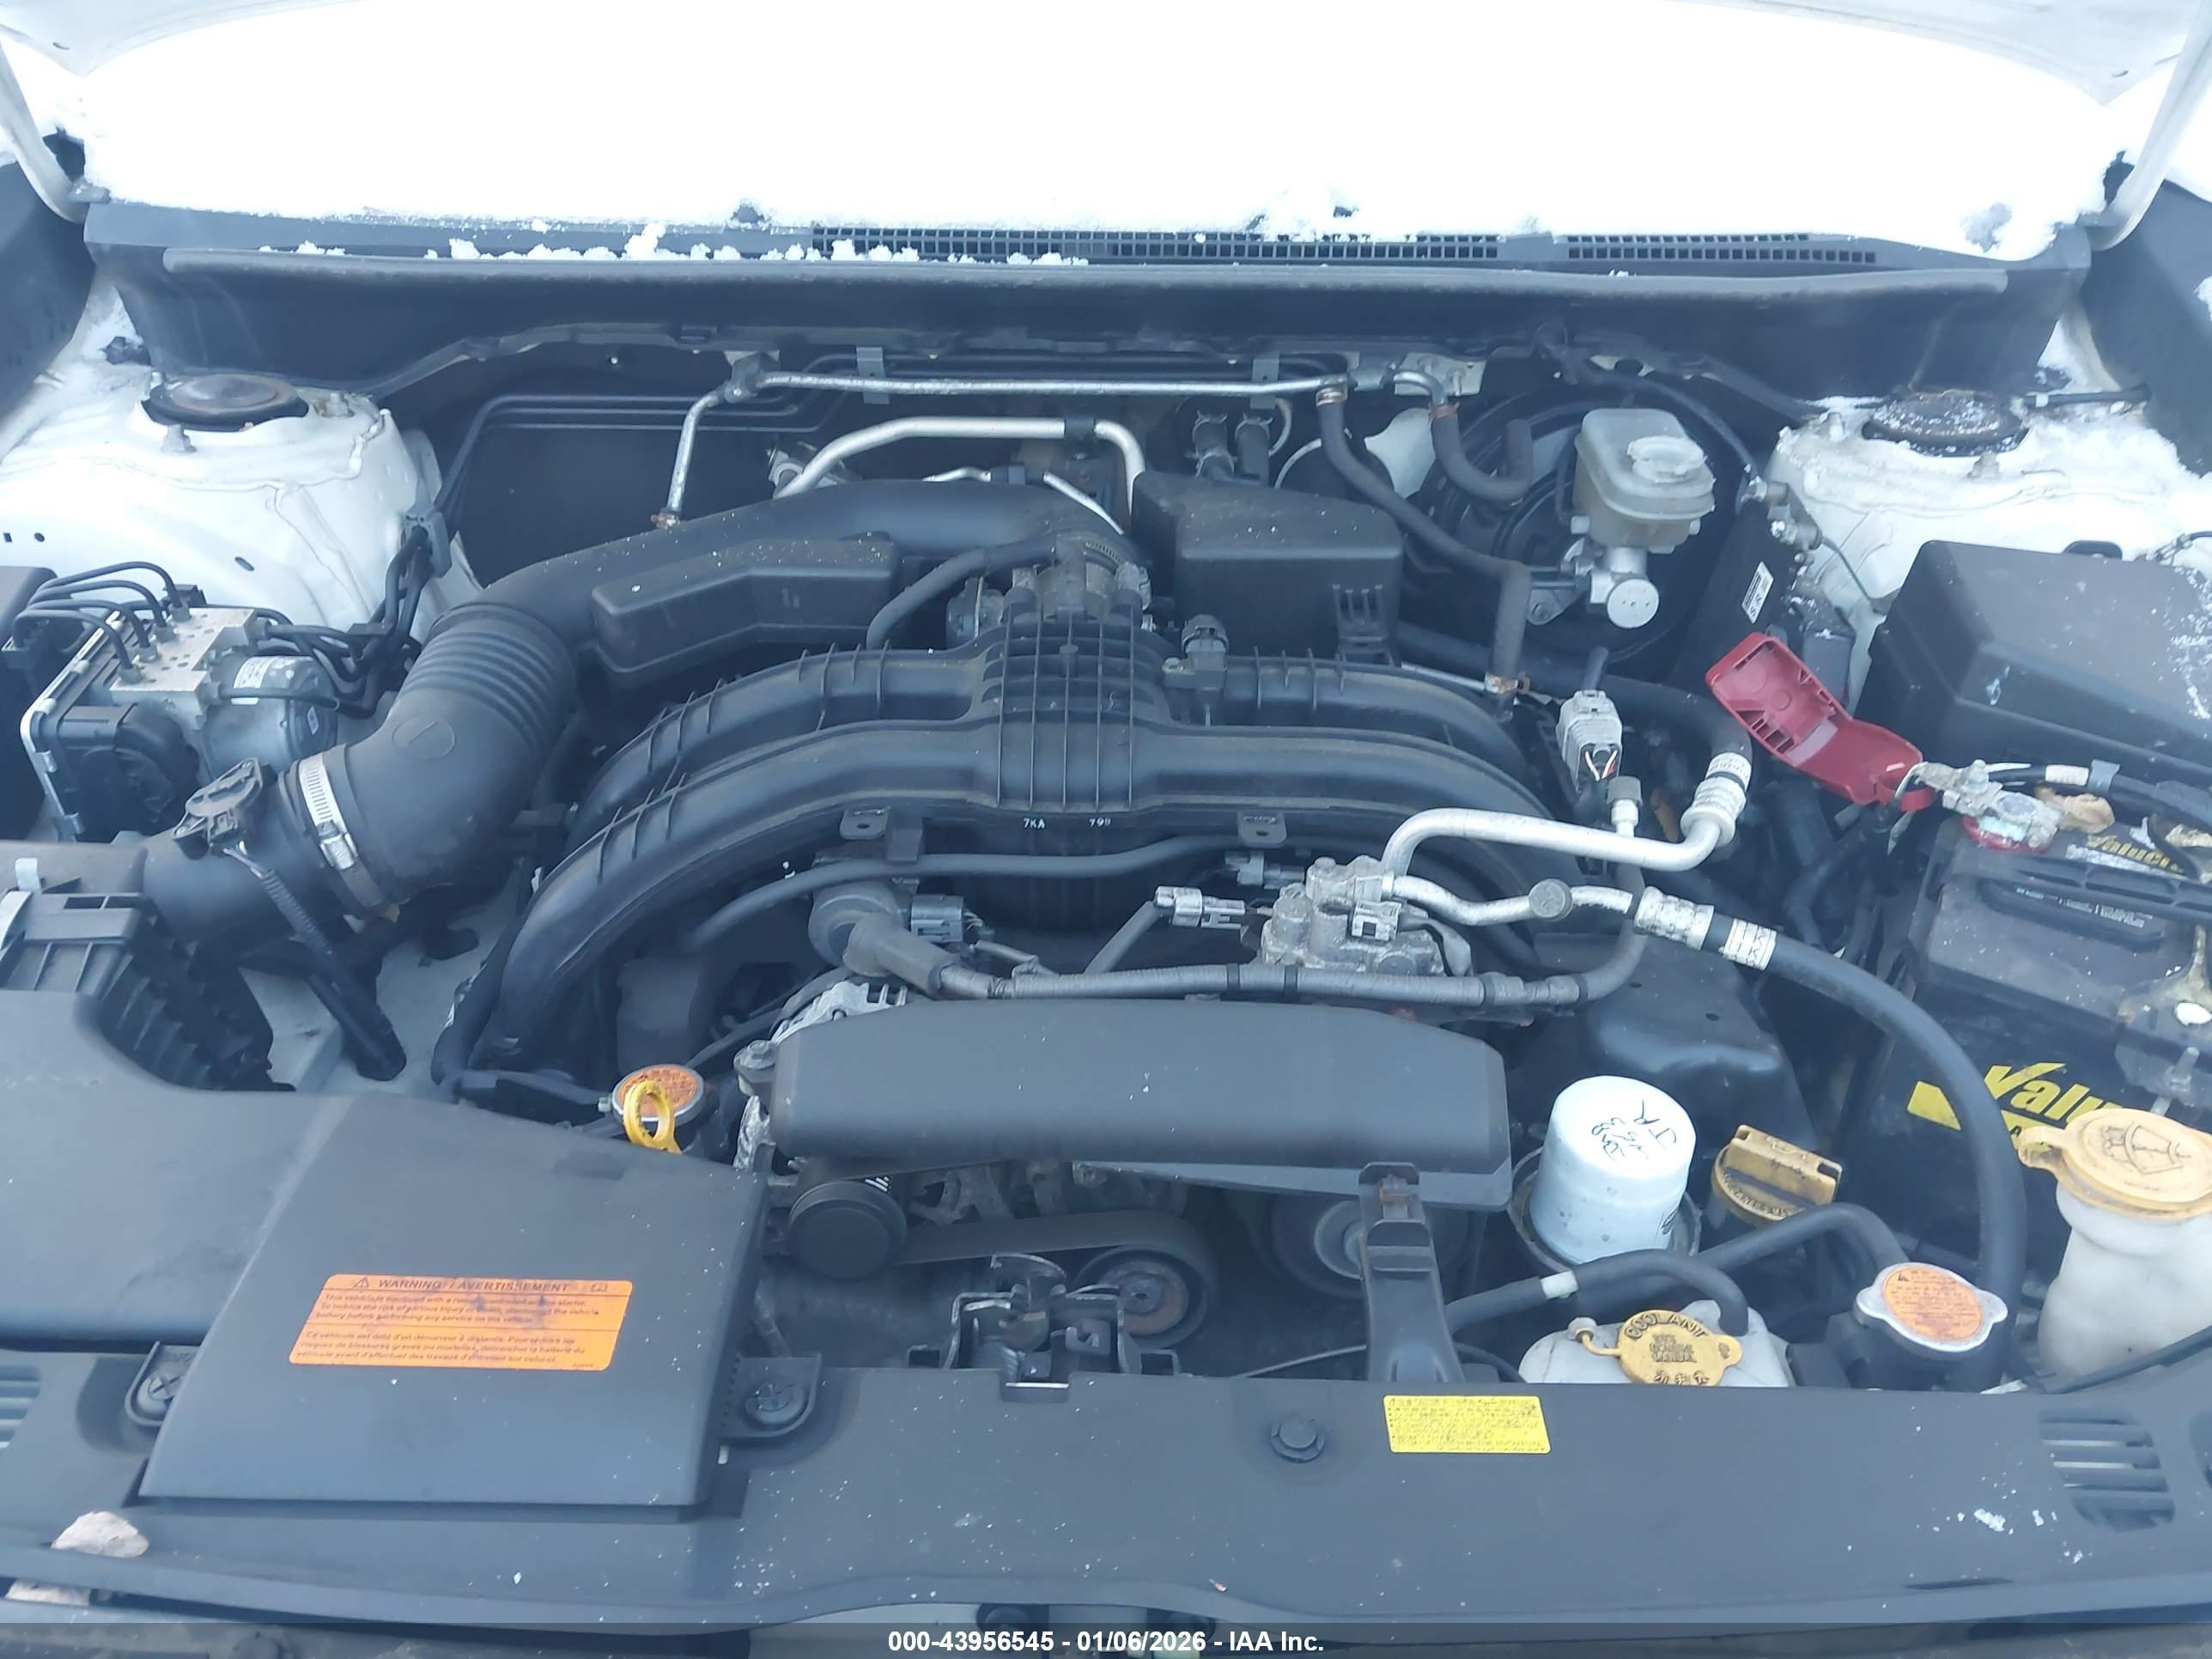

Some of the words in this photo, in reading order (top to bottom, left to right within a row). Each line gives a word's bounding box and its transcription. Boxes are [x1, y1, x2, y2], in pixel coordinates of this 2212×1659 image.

[378, 1279, 441, 1290] WARNING
[456, 1280, 568, 1293] AVERTISSEMENT
[1624, 1311, 1710, 1340] COOLANT
